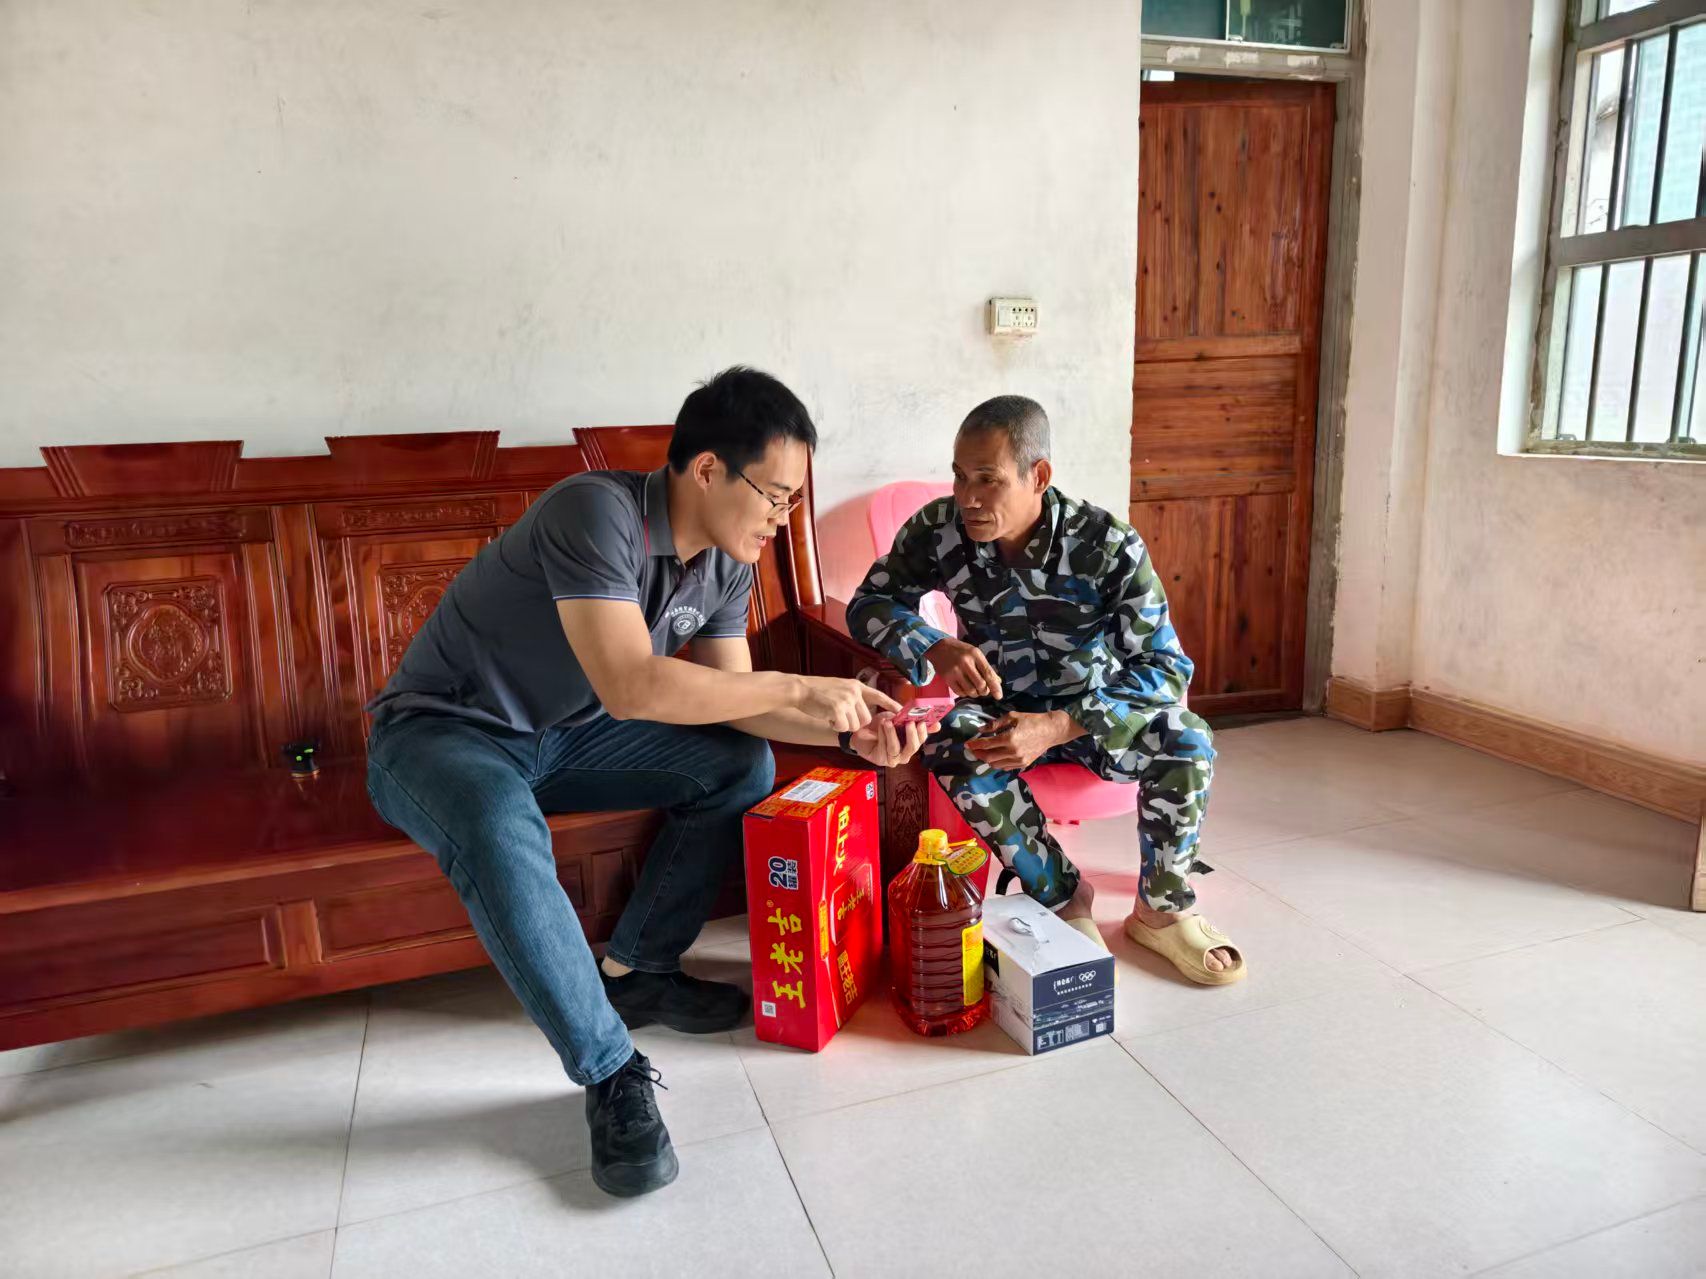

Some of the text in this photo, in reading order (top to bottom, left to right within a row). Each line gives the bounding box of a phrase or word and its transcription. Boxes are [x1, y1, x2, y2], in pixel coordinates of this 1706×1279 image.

[834, 805, 851, 876] 怕上火
[769, 857, 789, 889] 20
[787, 860, 798, 889] 罐装
[837, 887, 865, 922] 王老吉
[768, 908, 807, 1009] 王老吉
